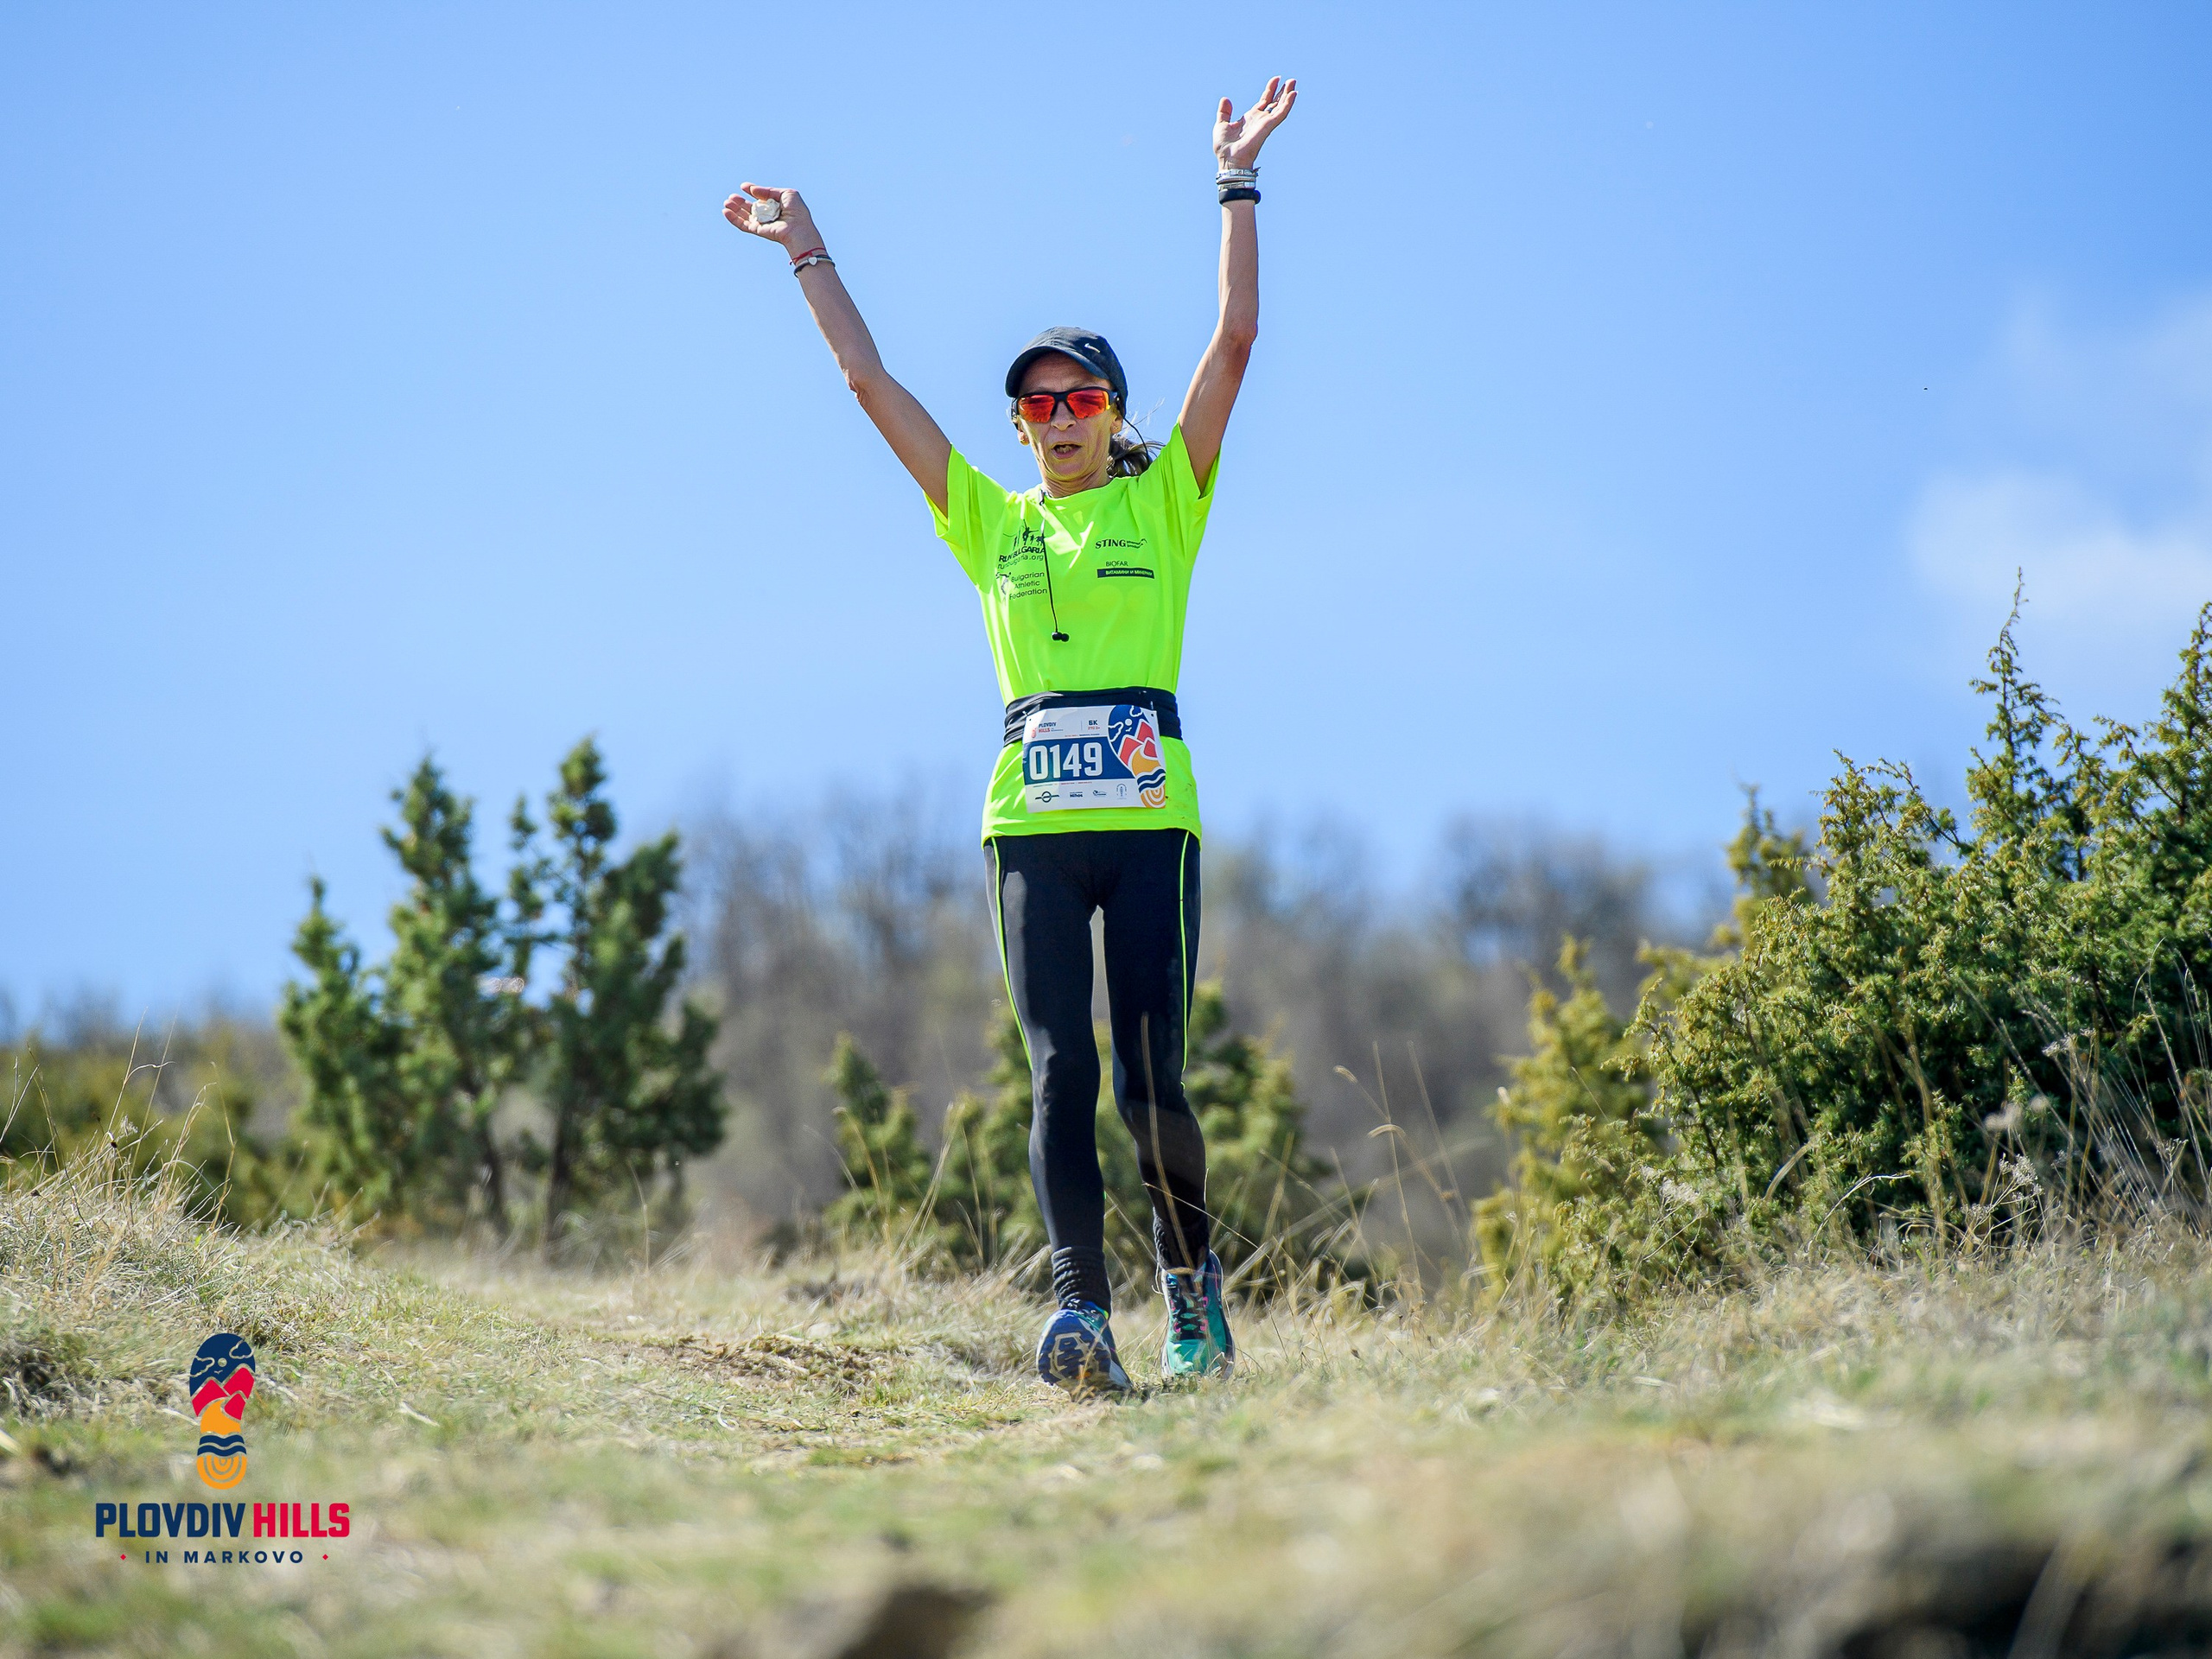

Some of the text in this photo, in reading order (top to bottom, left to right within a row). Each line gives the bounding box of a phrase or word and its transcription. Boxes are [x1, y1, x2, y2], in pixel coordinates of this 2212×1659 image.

[1095, 538, 1127, 550] STING
[1011, 571, 1045, 582] Bulgarian
[1014, 580, 1040, 589] Athletic
[1009, 588, 1048, 601] Federation
[1029, 742, 1103, 780] 0149
